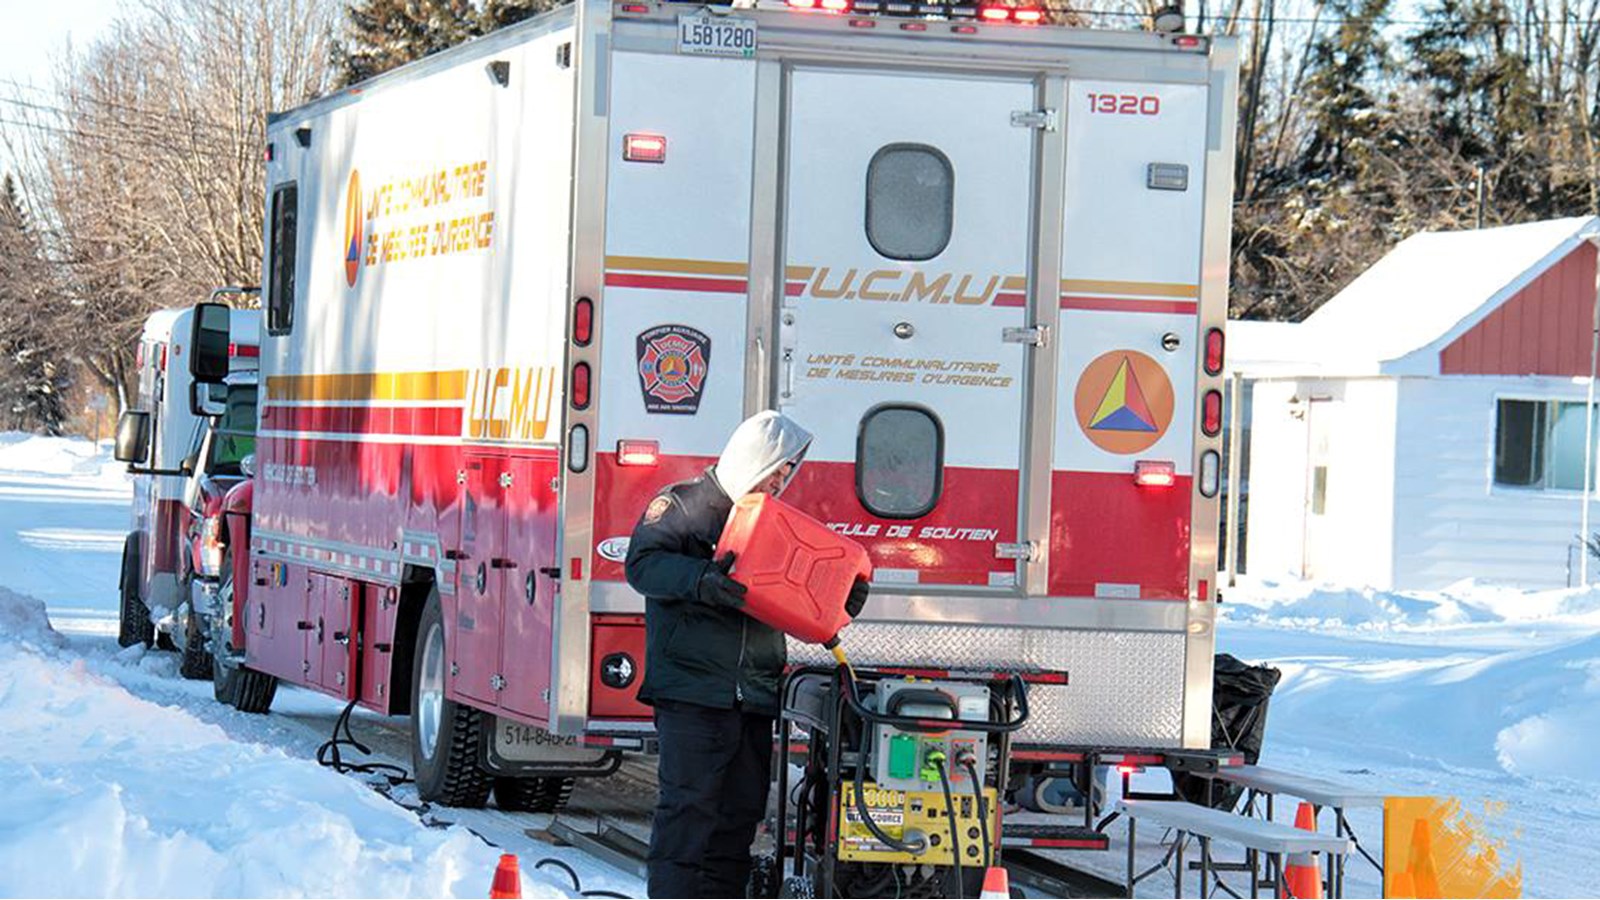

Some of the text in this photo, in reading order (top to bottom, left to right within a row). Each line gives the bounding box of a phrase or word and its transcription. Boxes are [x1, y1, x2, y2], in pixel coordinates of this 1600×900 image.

[682, 24, 754, 48] L581280
[1088, 93, 1160, 115] 1320
[809, 267, 1000, 305] U.C.M.U
[806, 354, 1001, 374] UNITÉ COMMUNAUTAIRE
[806, 367, 1013, 388] DE MESURES D'URGENCE
[885, 525, 913, 538] DE
[918, 526, 999, 541] SOUTIEN
